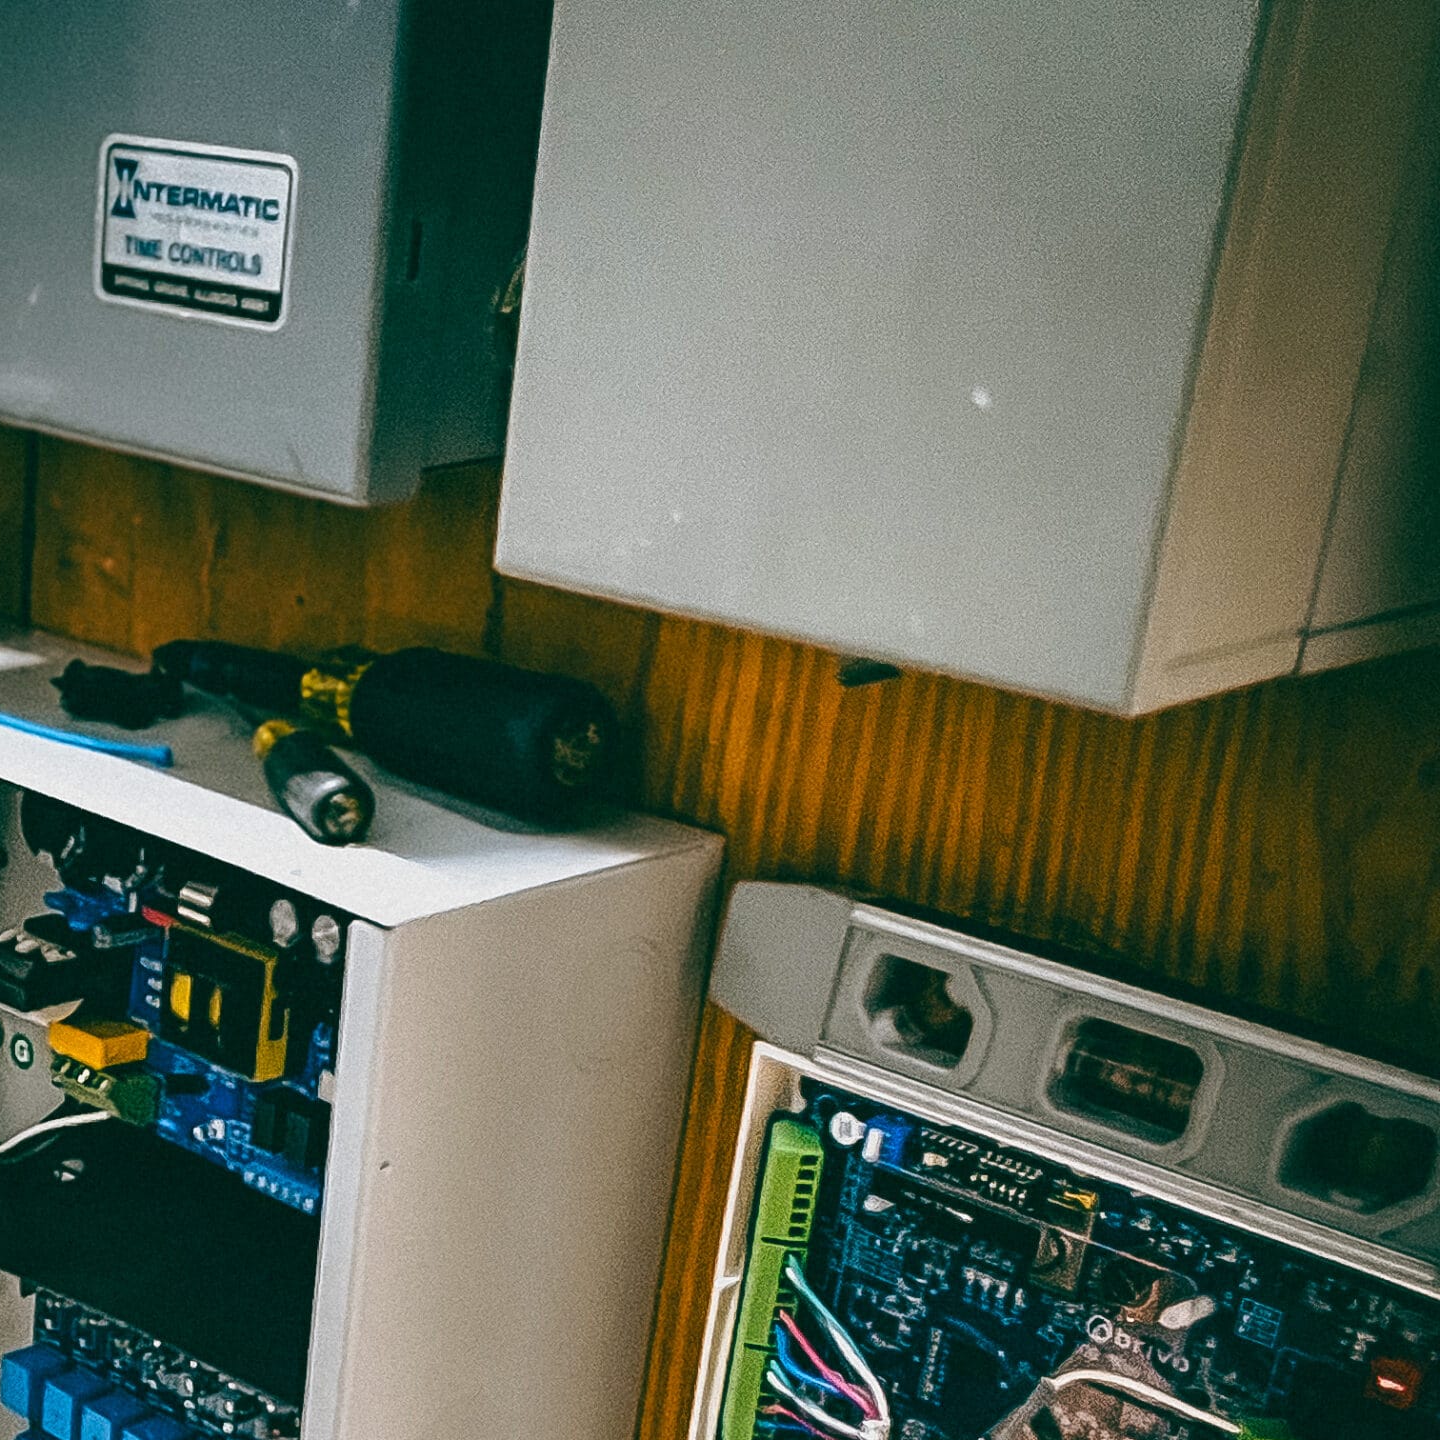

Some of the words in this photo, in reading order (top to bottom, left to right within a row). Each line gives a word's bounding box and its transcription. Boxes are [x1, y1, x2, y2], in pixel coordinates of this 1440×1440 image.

[125, 234, 162, 260] TIME
[168, 241, 263, 276] CONTROLS
[14, 1039, 30, 1062] G
